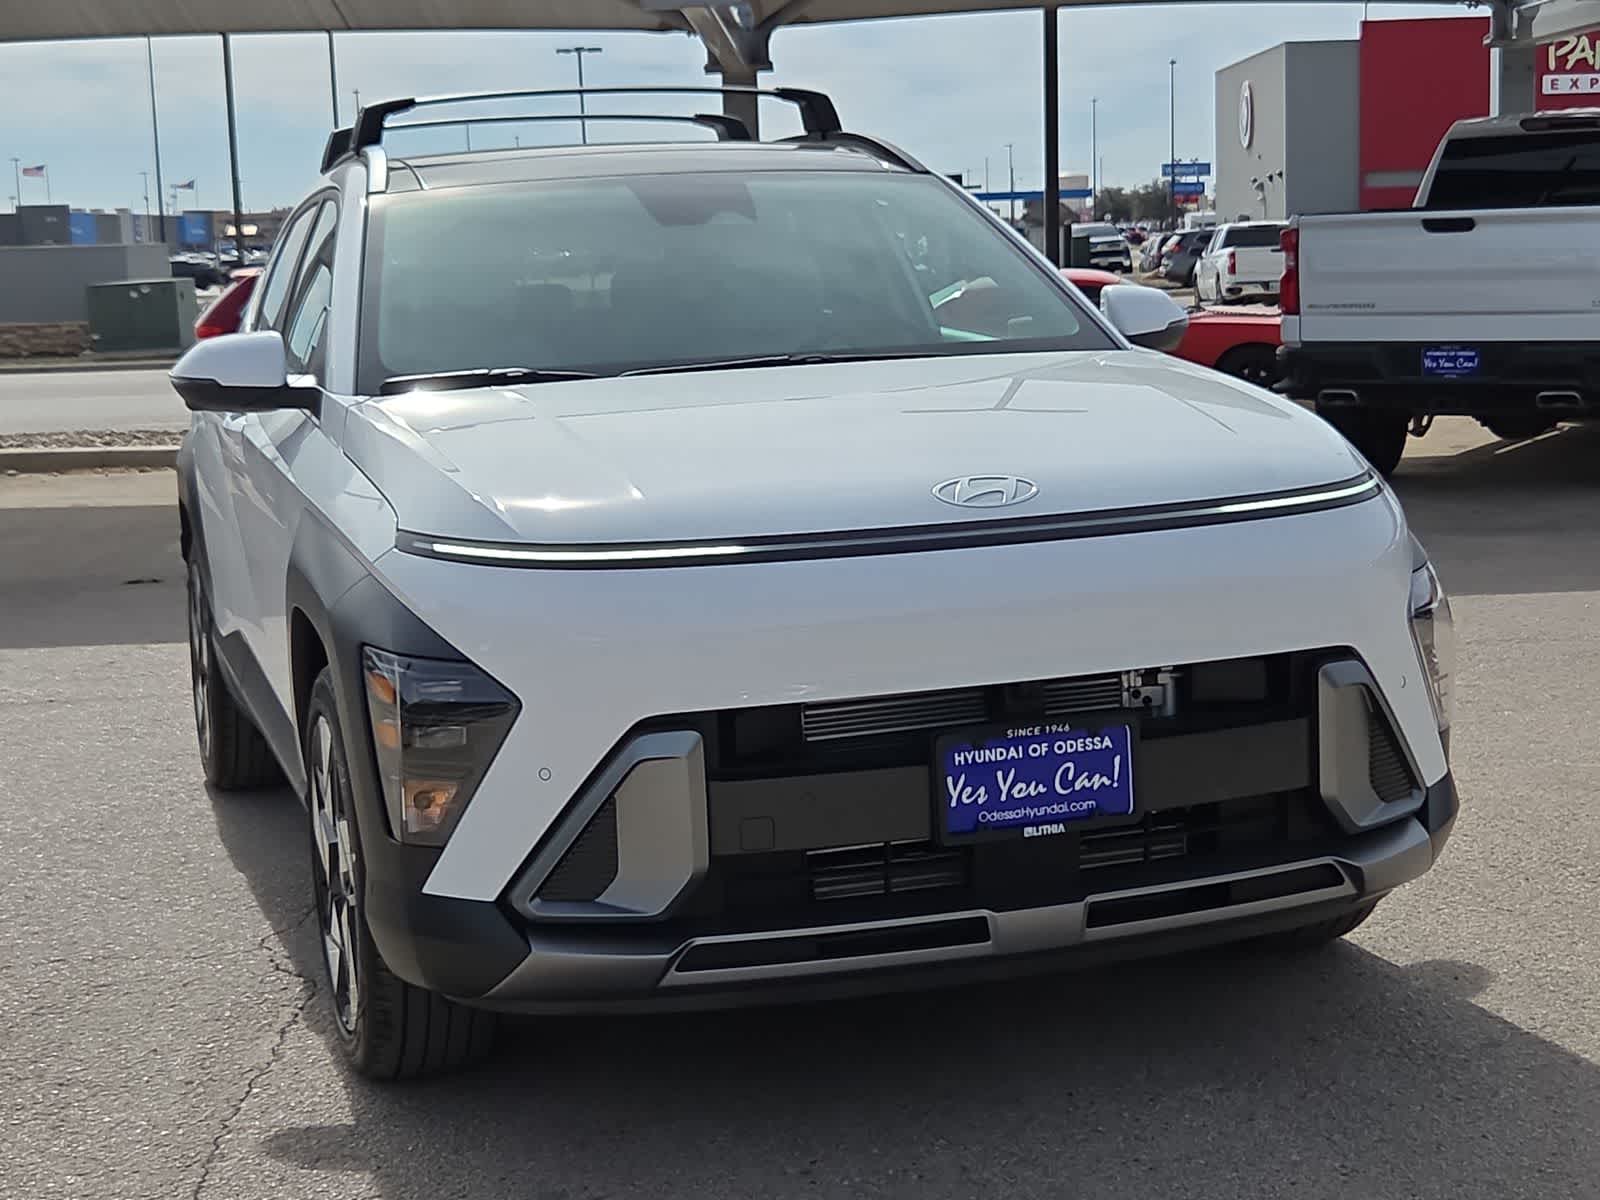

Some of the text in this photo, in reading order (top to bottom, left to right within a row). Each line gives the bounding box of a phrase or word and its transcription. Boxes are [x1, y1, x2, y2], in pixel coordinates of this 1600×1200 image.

[1007, 722, 1071, 738] SINCE 1946
[954, 736, 1113, 766] HYUNDAI OF ODESSA
[946, 755, 1121, 807] Yes You Can!
[978, 799, 1097, 824] OdessaHyundai.com
